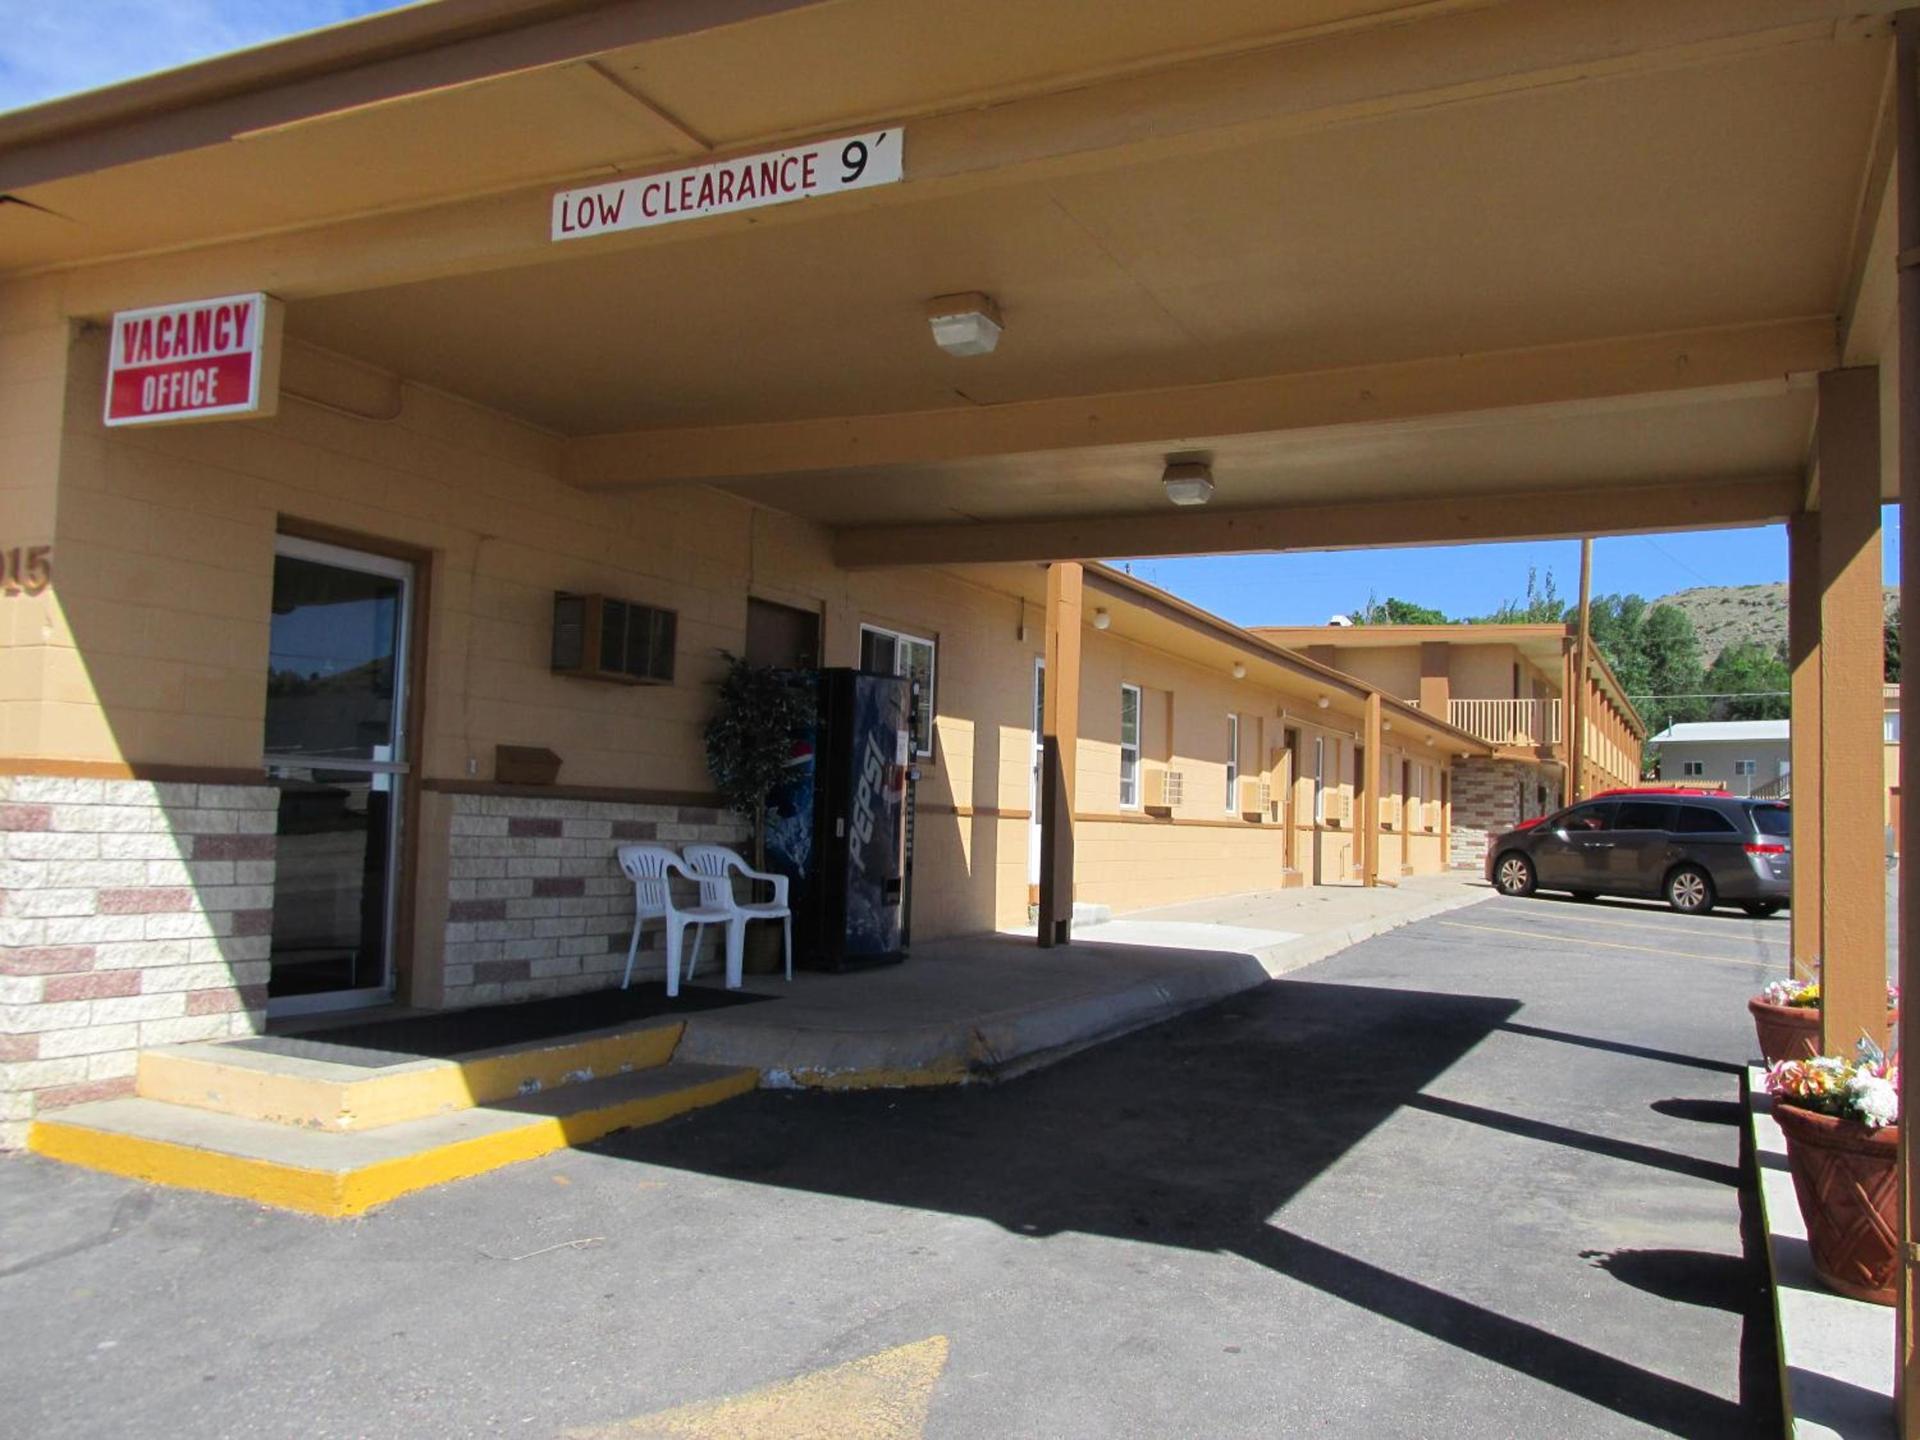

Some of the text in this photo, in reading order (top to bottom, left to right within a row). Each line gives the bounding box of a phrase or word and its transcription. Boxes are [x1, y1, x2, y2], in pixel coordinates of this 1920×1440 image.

[561, 189, 624, 233] LOW
[641, 152, 818, 218] CLEARANCE
[122, 302, 251, 365] VACANCY
[141, 366, 219, 413] OFFICE
[0, 545, 51, 597] 15
[849, 729, 885, 873] PEPSI
